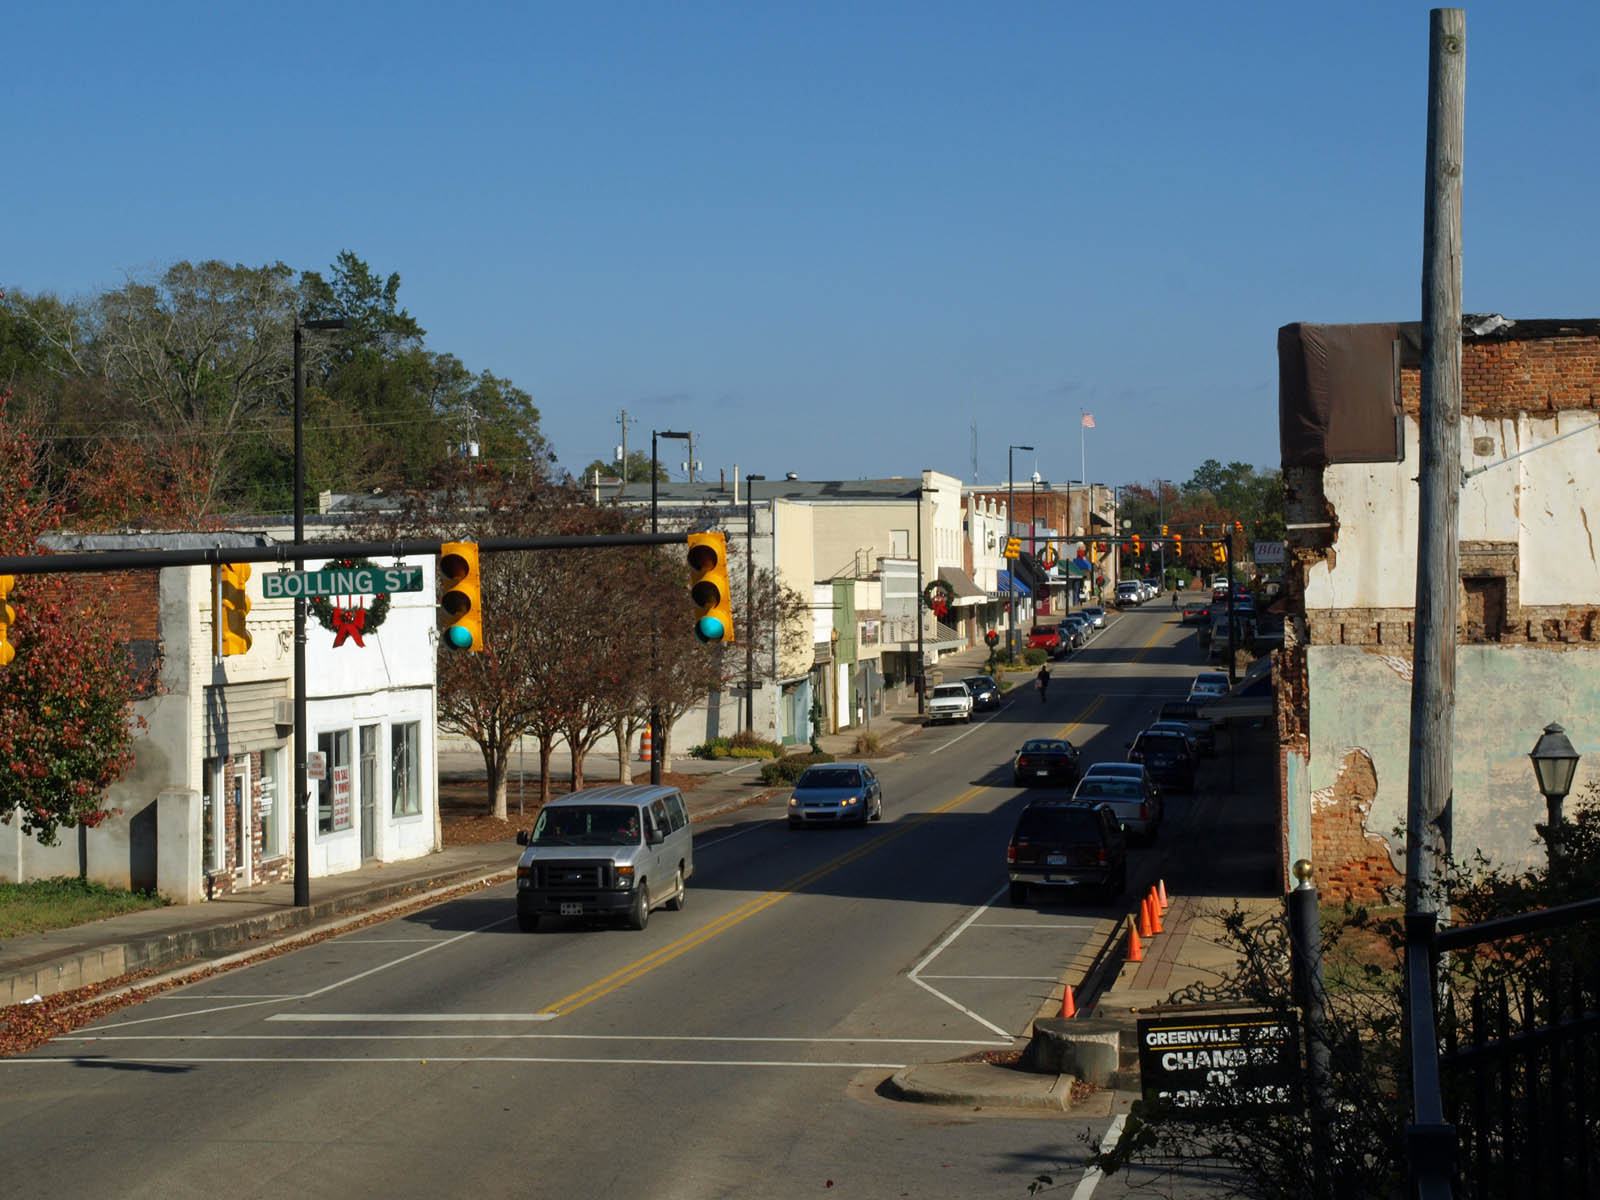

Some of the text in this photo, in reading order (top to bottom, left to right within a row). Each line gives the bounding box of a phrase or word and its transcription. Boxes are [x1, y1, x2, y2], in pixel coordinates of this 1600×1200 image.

[266, 569, 416, 597] BOLLING ST
[1146, 1028, 1240, 1045] GREENVILLE
